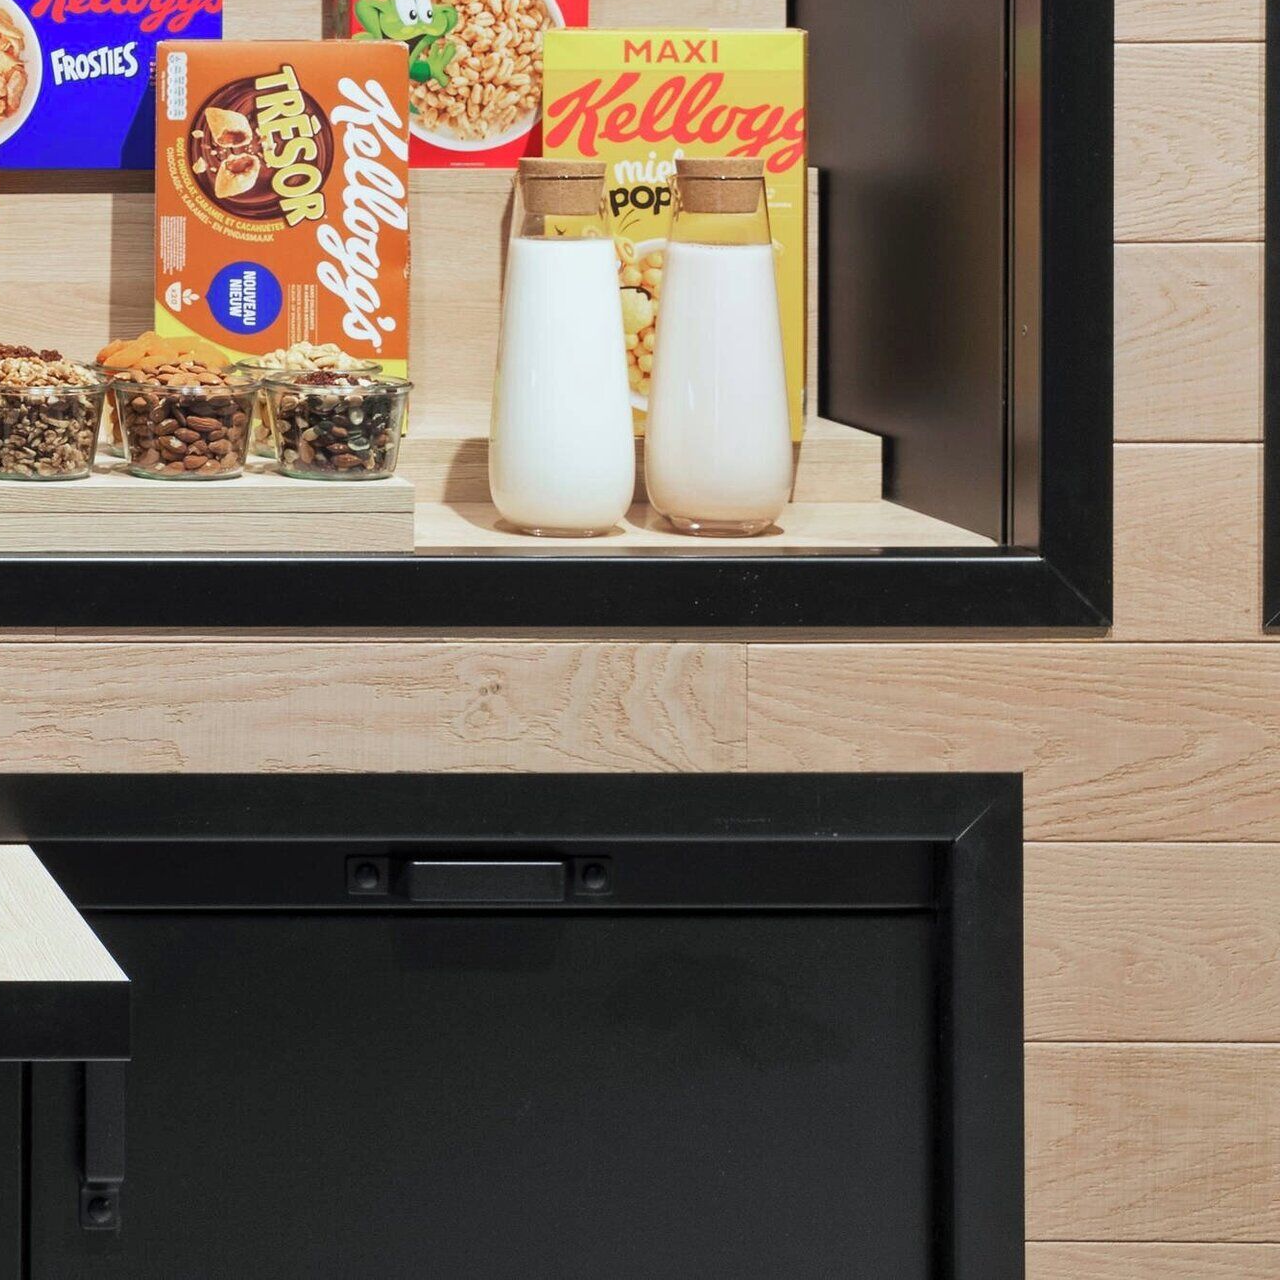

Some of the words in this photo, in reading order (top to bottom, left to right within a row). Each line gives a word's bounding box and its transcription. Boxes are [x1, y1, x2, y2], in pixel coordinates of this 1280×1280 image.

[50, 42, 137, 85] FROSTIES
[623, 39, 719, 64] MAXI
[255, 65, 325, 226] TRÉSOR
[195, 195, 225, 225] CARAMEL
[316, 77, 408, 350] Kellogg's
[609, 186, 671, 217] pop
[229, 279, 243, 317] NIEUW
[243, 271, 256, 326] NOUVEAU
